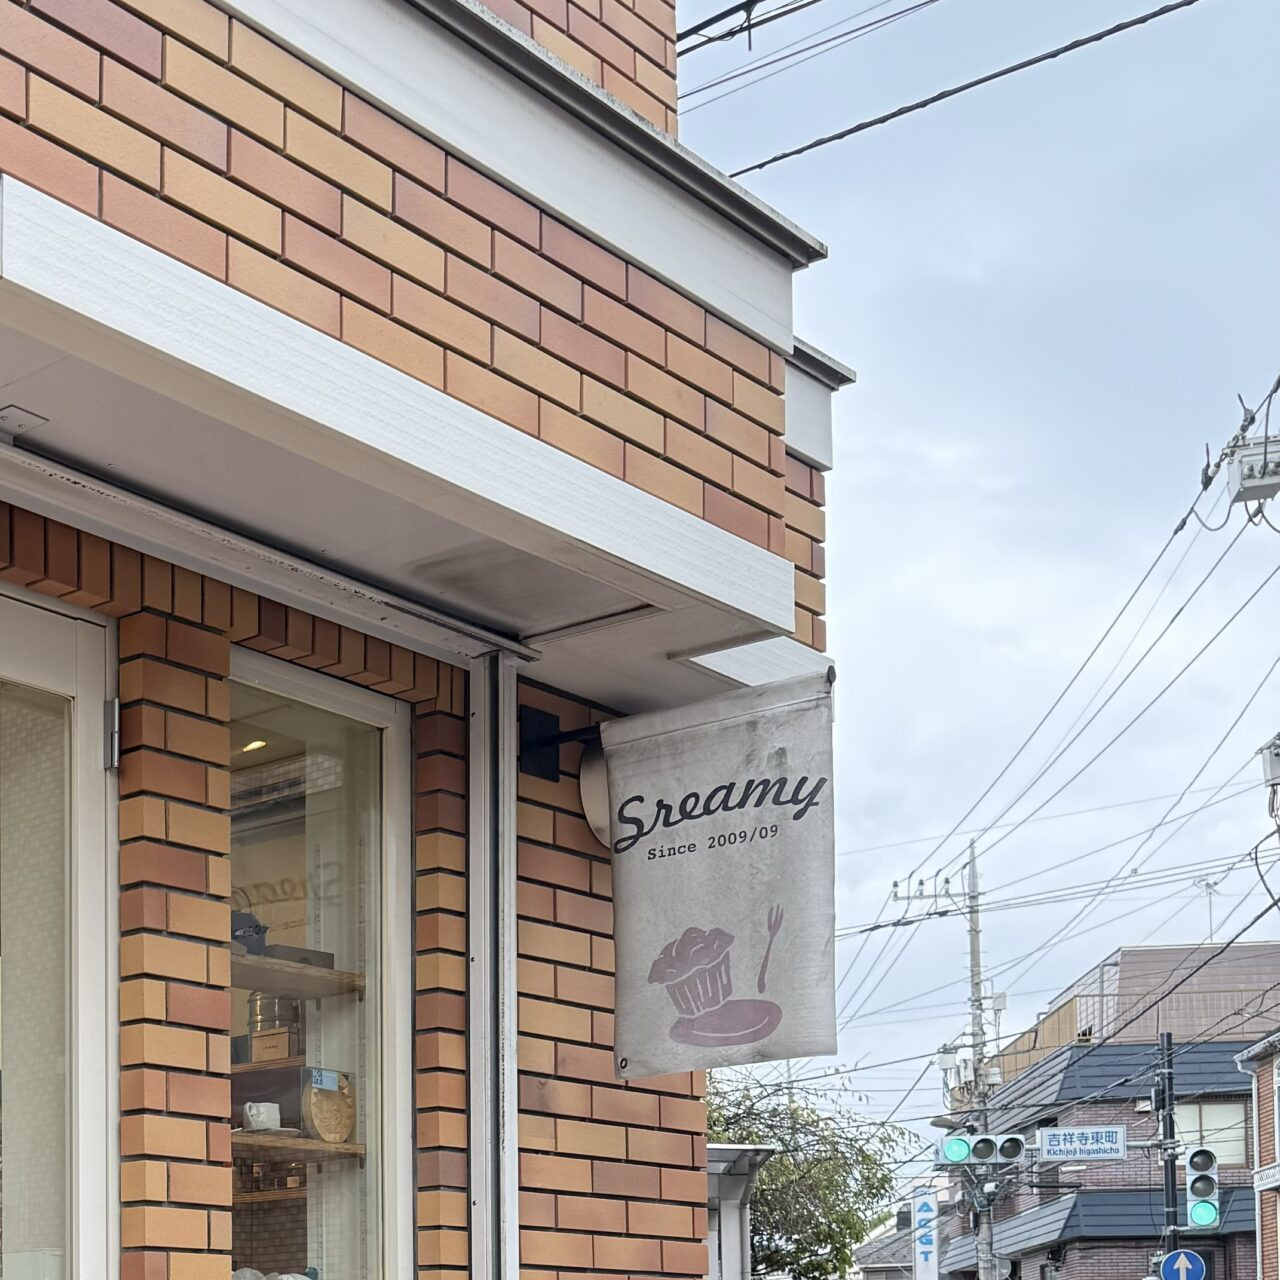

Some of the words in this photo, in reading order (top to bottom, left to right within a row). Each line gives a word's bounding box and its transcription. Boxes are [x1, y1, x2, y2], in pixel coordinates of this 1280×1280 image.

[613, 776, 828, 854] Sreamy
[647, 843, 697, 860] Since
[708, 824, 779, 849] 2009/09
[1047, 1130, 1118, 1147] 吉祥寺東町
[1047, 1148, 1078, 1157] Kichijoji
[1080, 1147, 1120, 1156] higashicho
